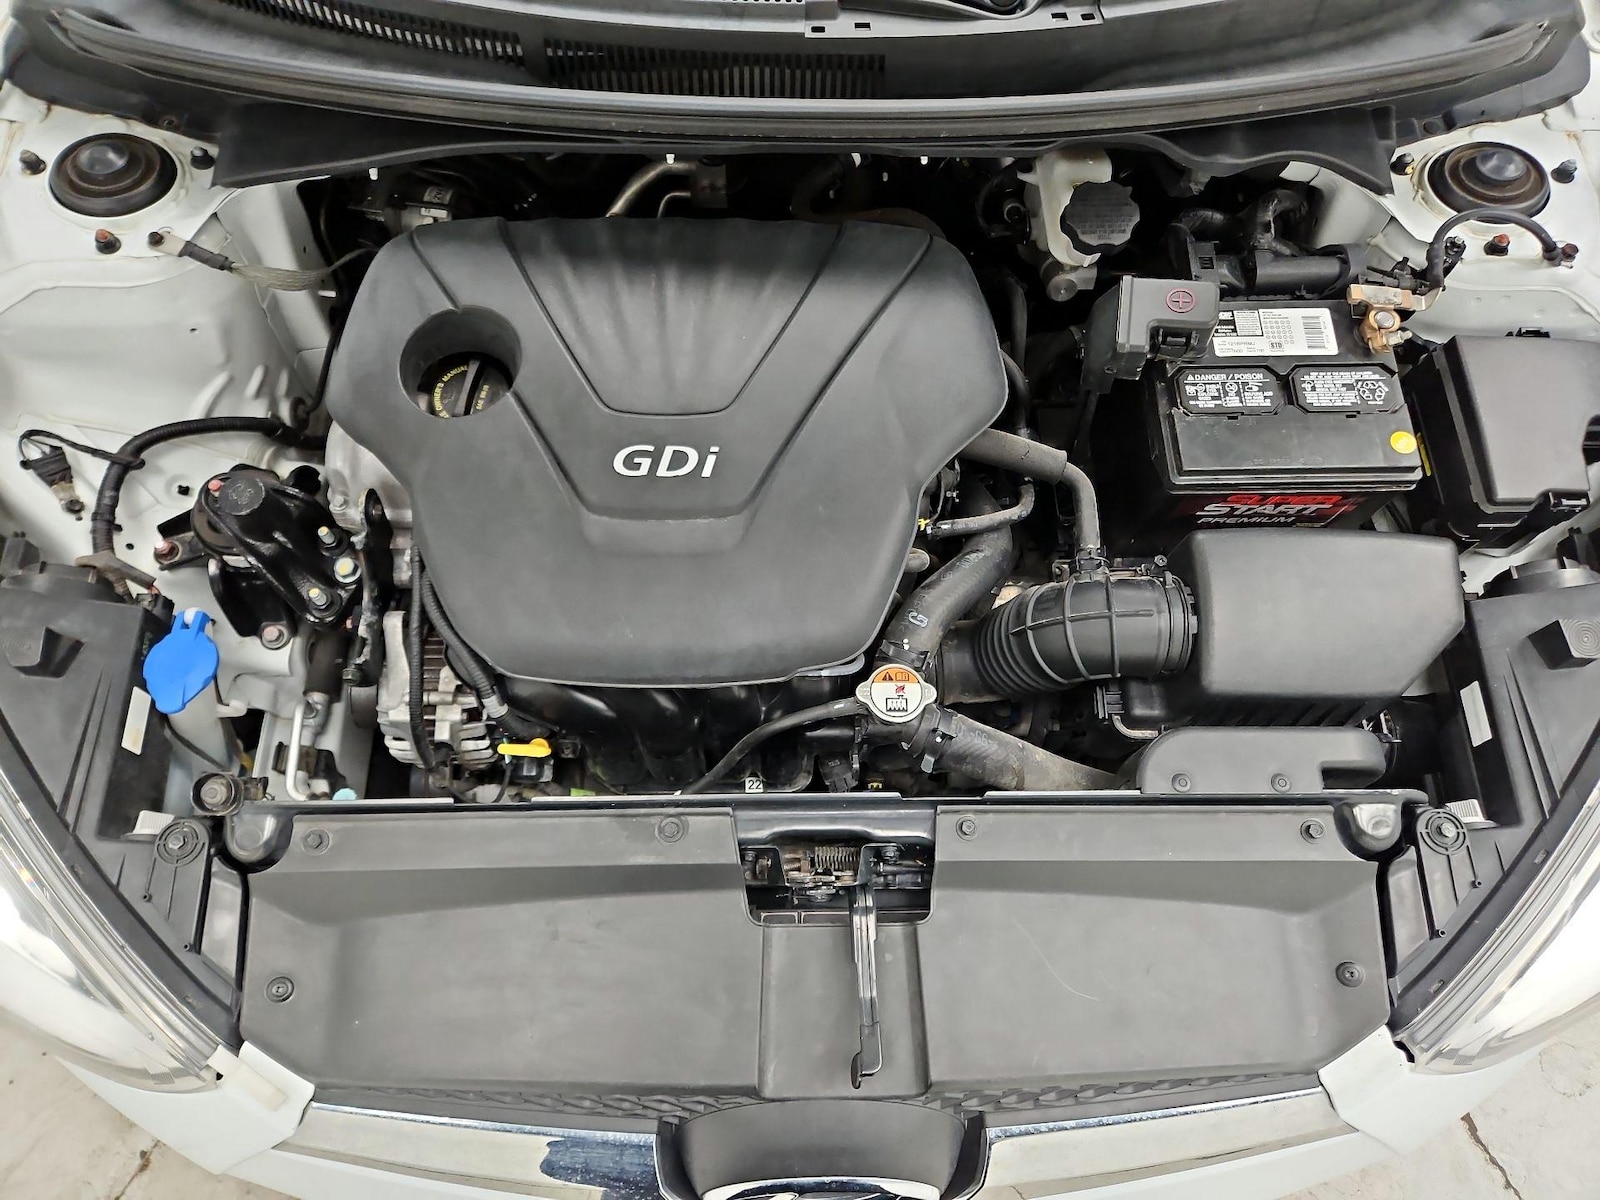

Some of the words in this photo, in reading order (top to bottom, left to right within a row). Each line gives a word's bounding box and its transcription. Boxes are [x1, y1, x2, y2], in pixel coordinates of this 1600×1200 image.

[442, 365, 469, 382] MANUAL
[612, 444, 720, 478] GDi
[1223, 495, 1342, 505] SUPER
[1195, 503, 1334, 516] START
[1197, 516, 1297, 524] PREMIUM
[748, 779, 762, 790] 22
